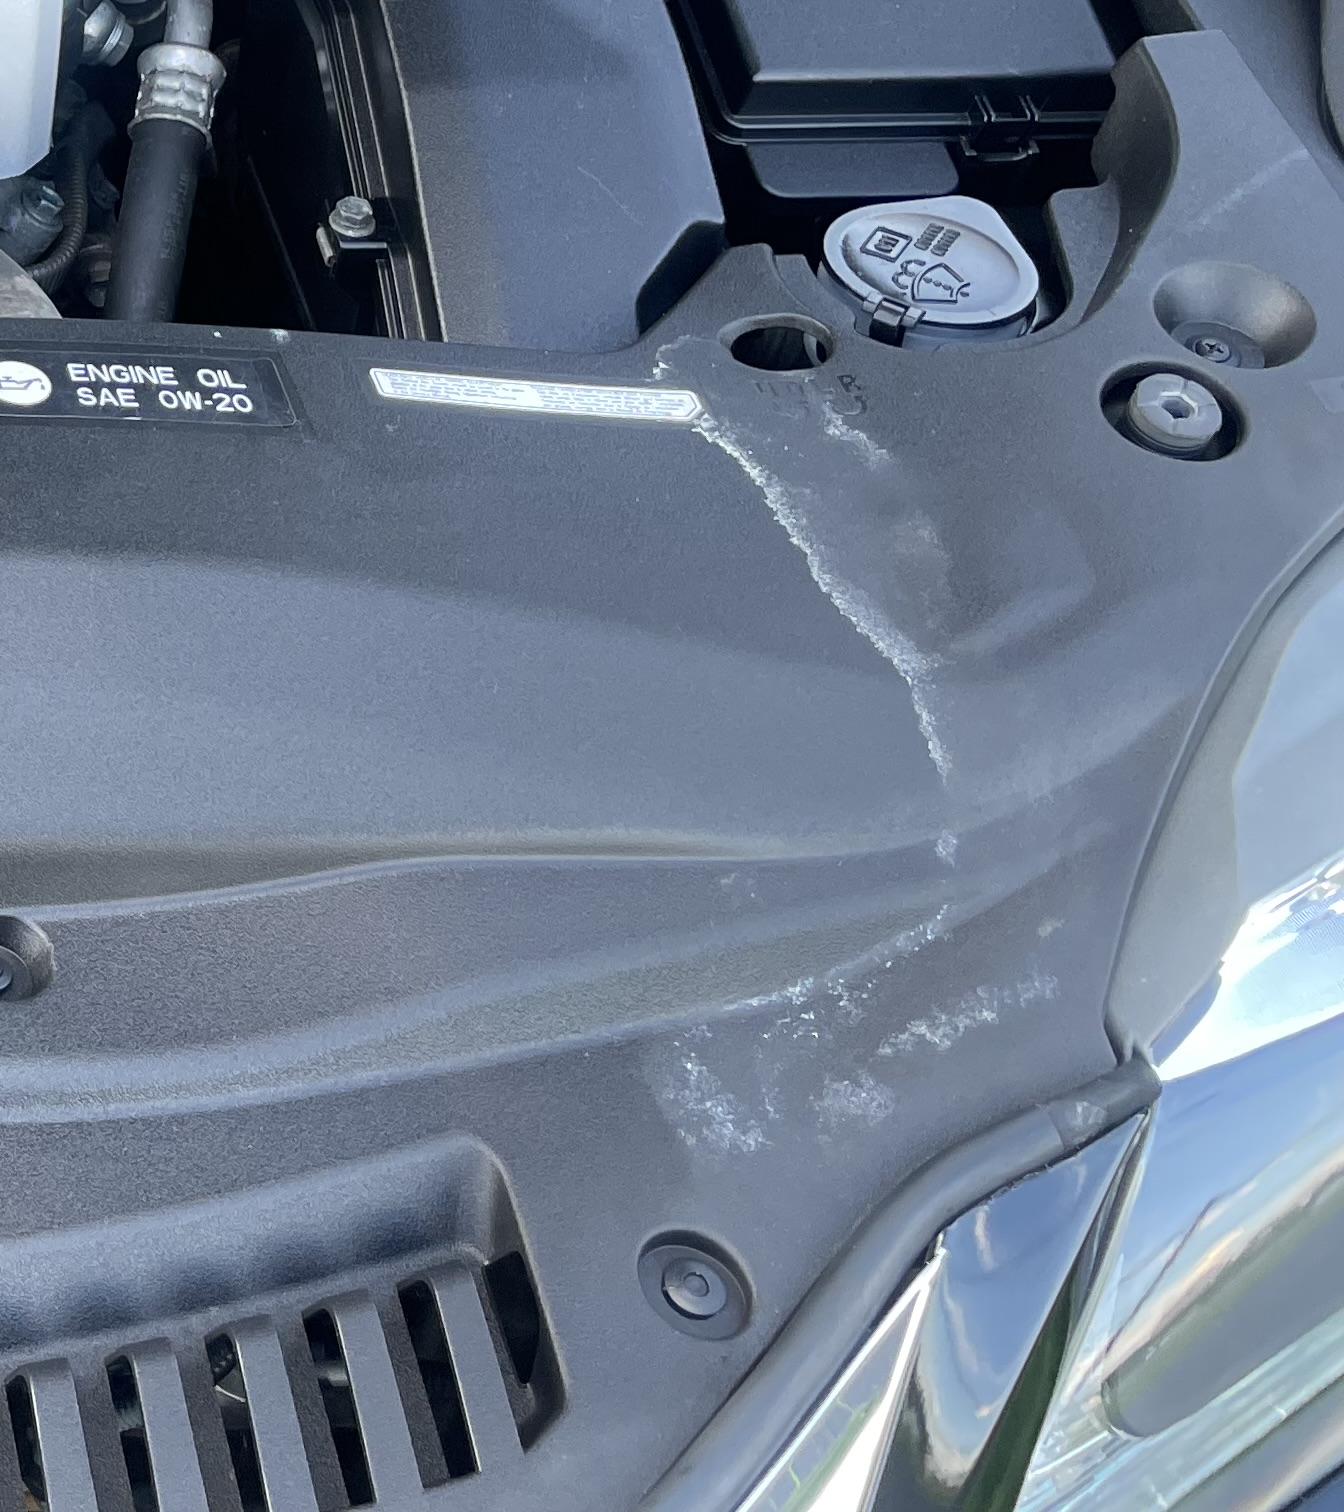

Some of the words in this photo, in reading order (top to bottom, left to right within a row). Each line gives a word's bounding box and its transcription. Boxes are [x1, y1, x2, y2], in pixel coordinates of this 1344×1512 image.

[66, 362, 179, 386] ENGINE
[196, 368, 248, 390] OIL
[78, 387, 140, 408] SAE
[158, 391, 254, 414] 0W-20
